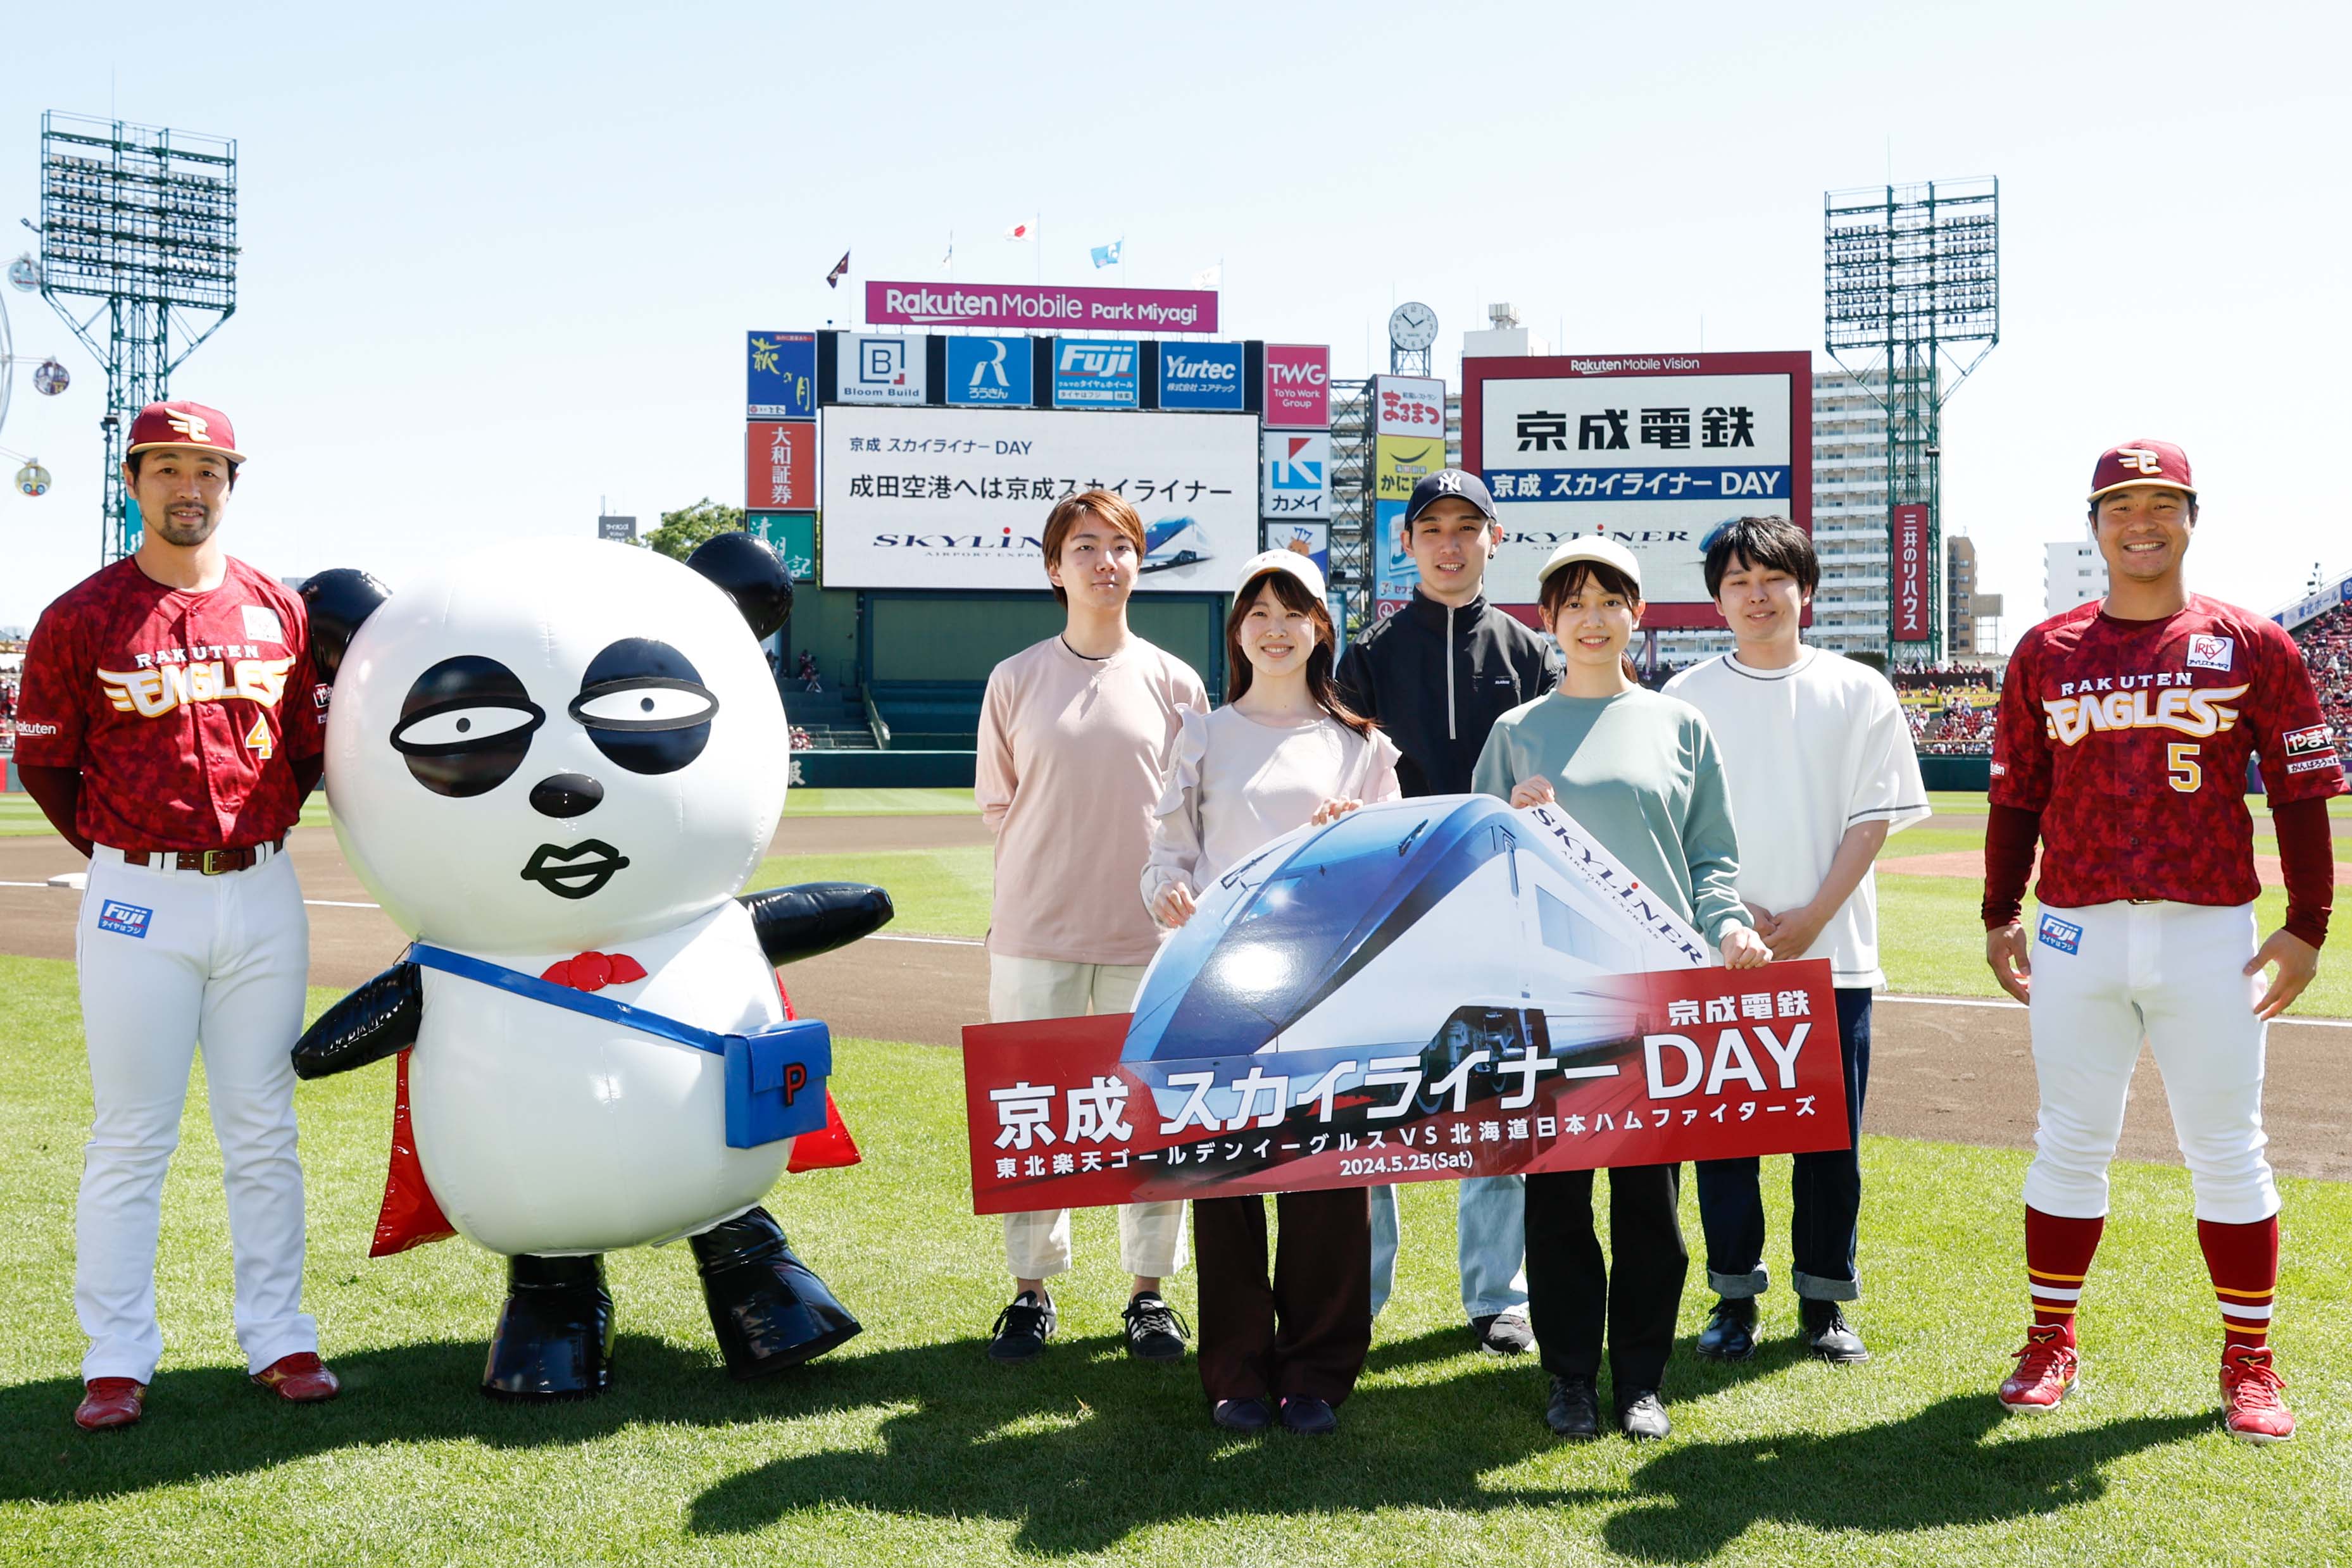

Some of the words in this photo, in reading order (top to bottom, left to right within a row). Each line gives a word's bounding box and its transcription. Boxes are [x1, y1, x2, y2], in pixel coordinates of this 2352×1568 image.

[886, 288, 998, 321] Rakuten
[1002, 294, 1083, 318] Mobile
[1091, 303, 1134, 320] Park
[1137, 304, 1198, 325] Miyagi
[1059, 344, 1134, 378] Fuji
[1166, 355, 1235, 380] Yurtec
[1268, 362, 1326, 385] TWG
[1571, 358, 1622, 375] Rakuten
[1623, 358, 1660, 370] Mobile
[1663, 358, 1700, 370] Vision
[844, 387, 883, 396] Bloom
[888, 388, 919, 397] Build
[969, 387, 1008, 399] ろうきん
[1167, 383, 1197, 392] 株式会社
[1199, 383, 1235, 393] ユアテック
[1297, 389, 1321, 399] Work
[1282, 399, 1312, 409] Group
[1382, 390, 1441, 425] まるまつ
[1517, 406, 1755, 452] 京成電鉄
[849, 437, 880, 452] 京成
[887, 439, 990, 452] スカイライナー
[996, 441, 1032, 456] DAY
[771, 426, 792, 504] 大和証券
[1492, 474, 1541, 498] 京成
[1550, 473, 1713, 497] スカイライナー
[1720, 471, 1780, 495] DAY
[1272, 495, 1322, 511] カメイ
[1903, 514, 1918, 630] 三井のリハウス
[2299, 590, 2338, 619] 東北ボール
[135, 644, 260, 668] RAKUTEN
[2195, 642, 2217, 654] IRIS
[97, 654, 296, 718] EAGLES
[2061, 672, 2192, 696] RAKUTEN
[2042, 683, 2250, 746] EAGLES
[245, 712, 272, 759] 4
[2168, 743, 2201, 792] 5
[1561, 850, 1608, 892] AIRPORT
[104, 903, 147, 925] Fuji
[2042, 918, 2079, 942] Fuji
[1668, 990, 1811, 1027] 京成電鉄
[783, 1062, 807, 1107] P
[989, 1074, 1134, 1151] 京成
[1159, 1043, 1621, 1136] スカイライナー
[1642, 1021, 1813, 1102] DAY
[996, 1131, 1387, 1180] 東北楽天ゴールデンイーグルス
[1399, 1129, 1439, 1147] VS
[1451, 1094, 1817, 1144] 北海道日本ハムファイターズ
[1339, 1152, 1473, 1178] 2024.5.25(Sat)
